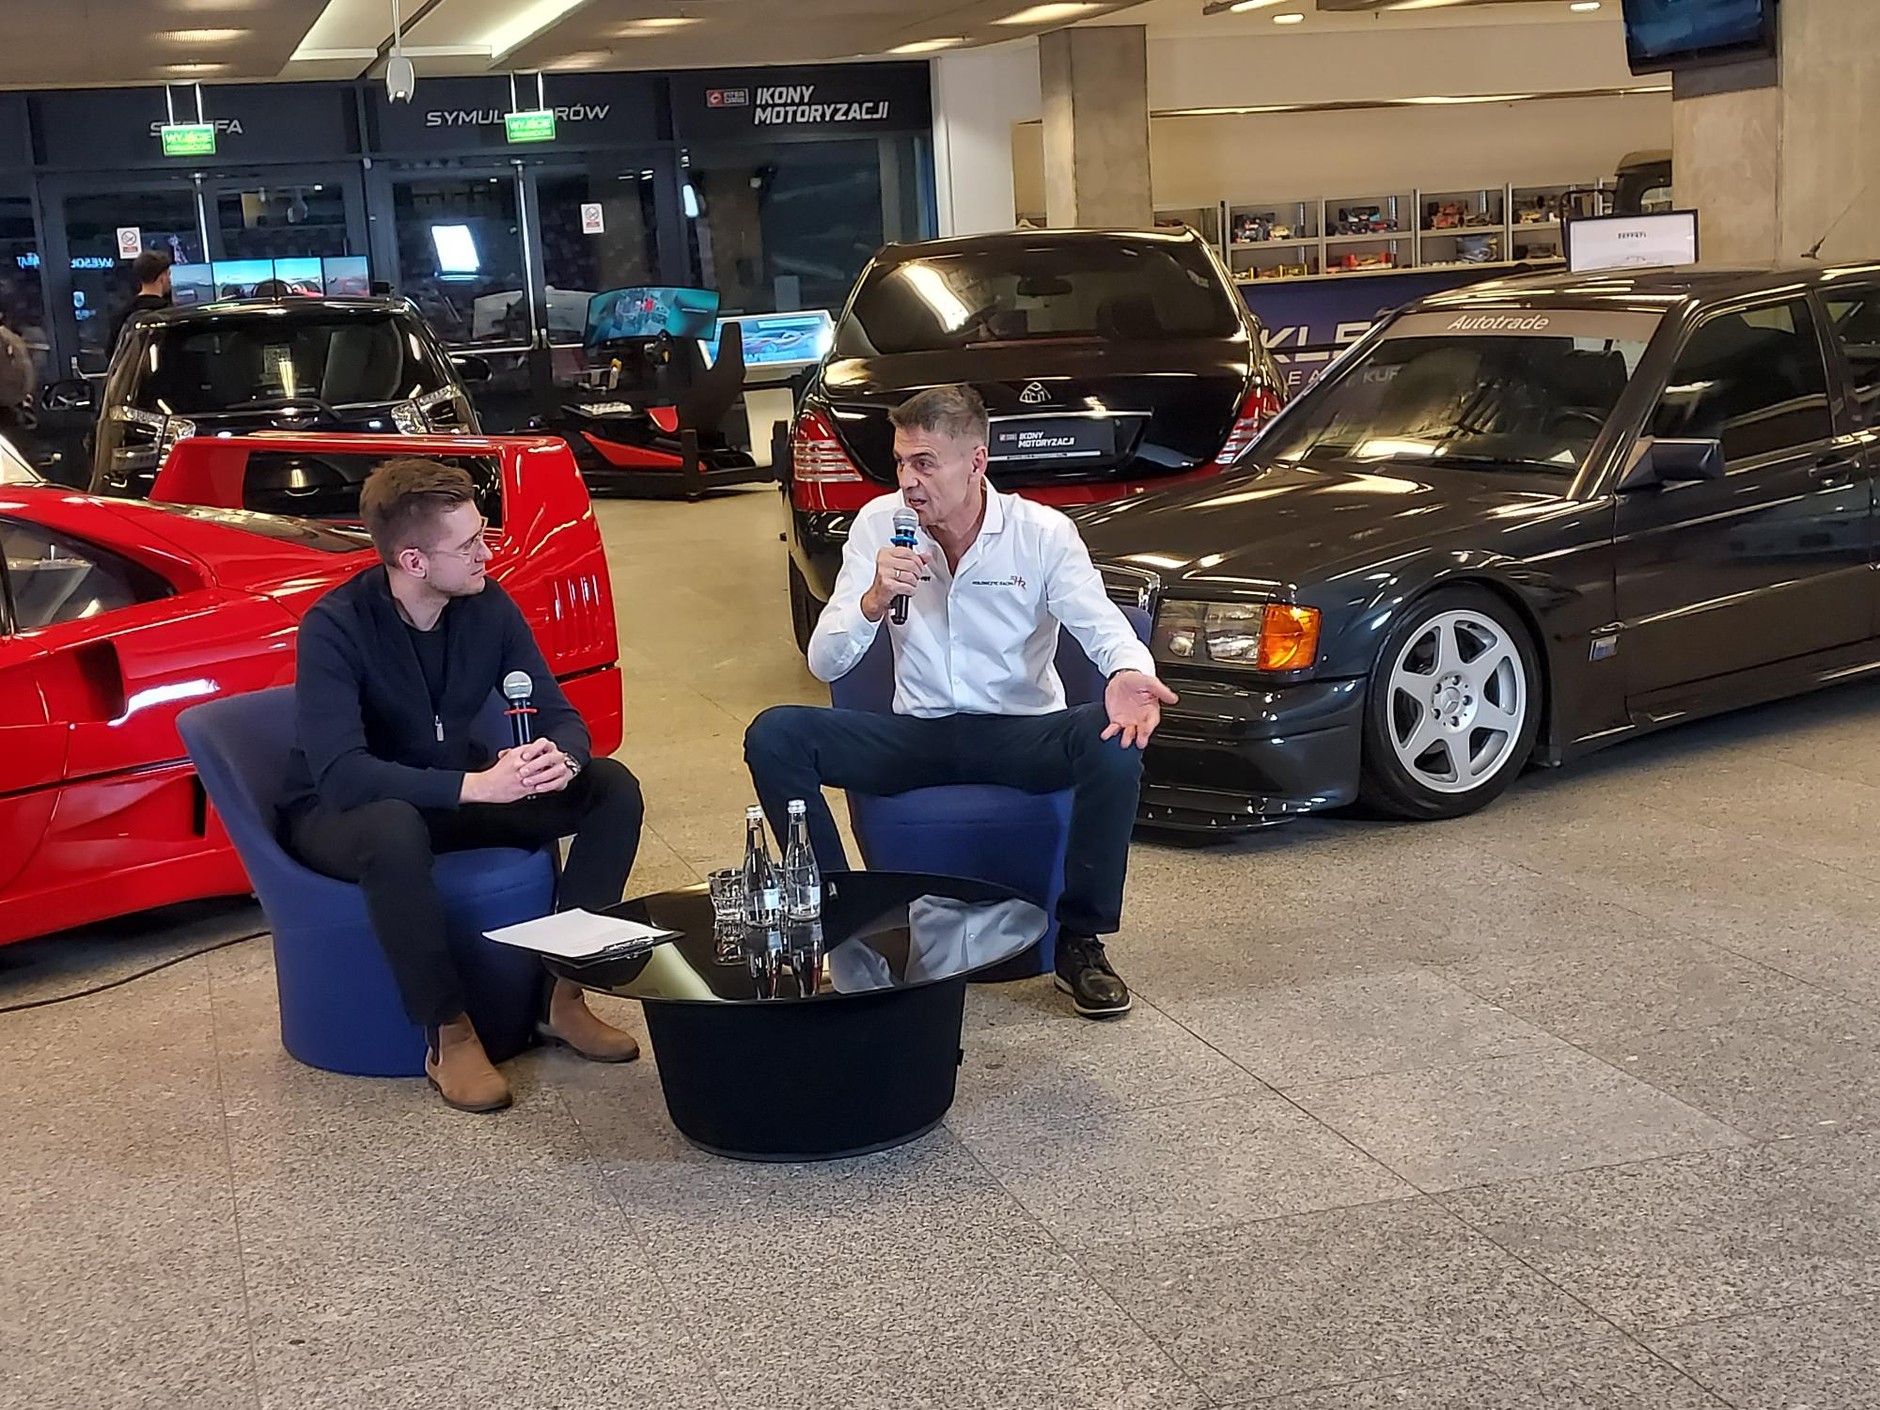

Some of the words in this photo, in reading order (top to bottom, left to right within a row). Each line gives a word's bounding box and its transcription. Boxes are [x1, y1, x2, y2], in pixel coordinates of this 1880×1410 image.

[756, 85, 815, 105] IKONY
[426, 103, 610, 126] SYMULRÓW
[754, 101, 889, 125] MOTORYZACJI
[1447, 315, 1550, 330] Autotrade
[1018, 437, 1075, 448] MOTORYZACJI
[1019, 431, 1044, 440] IKONY
